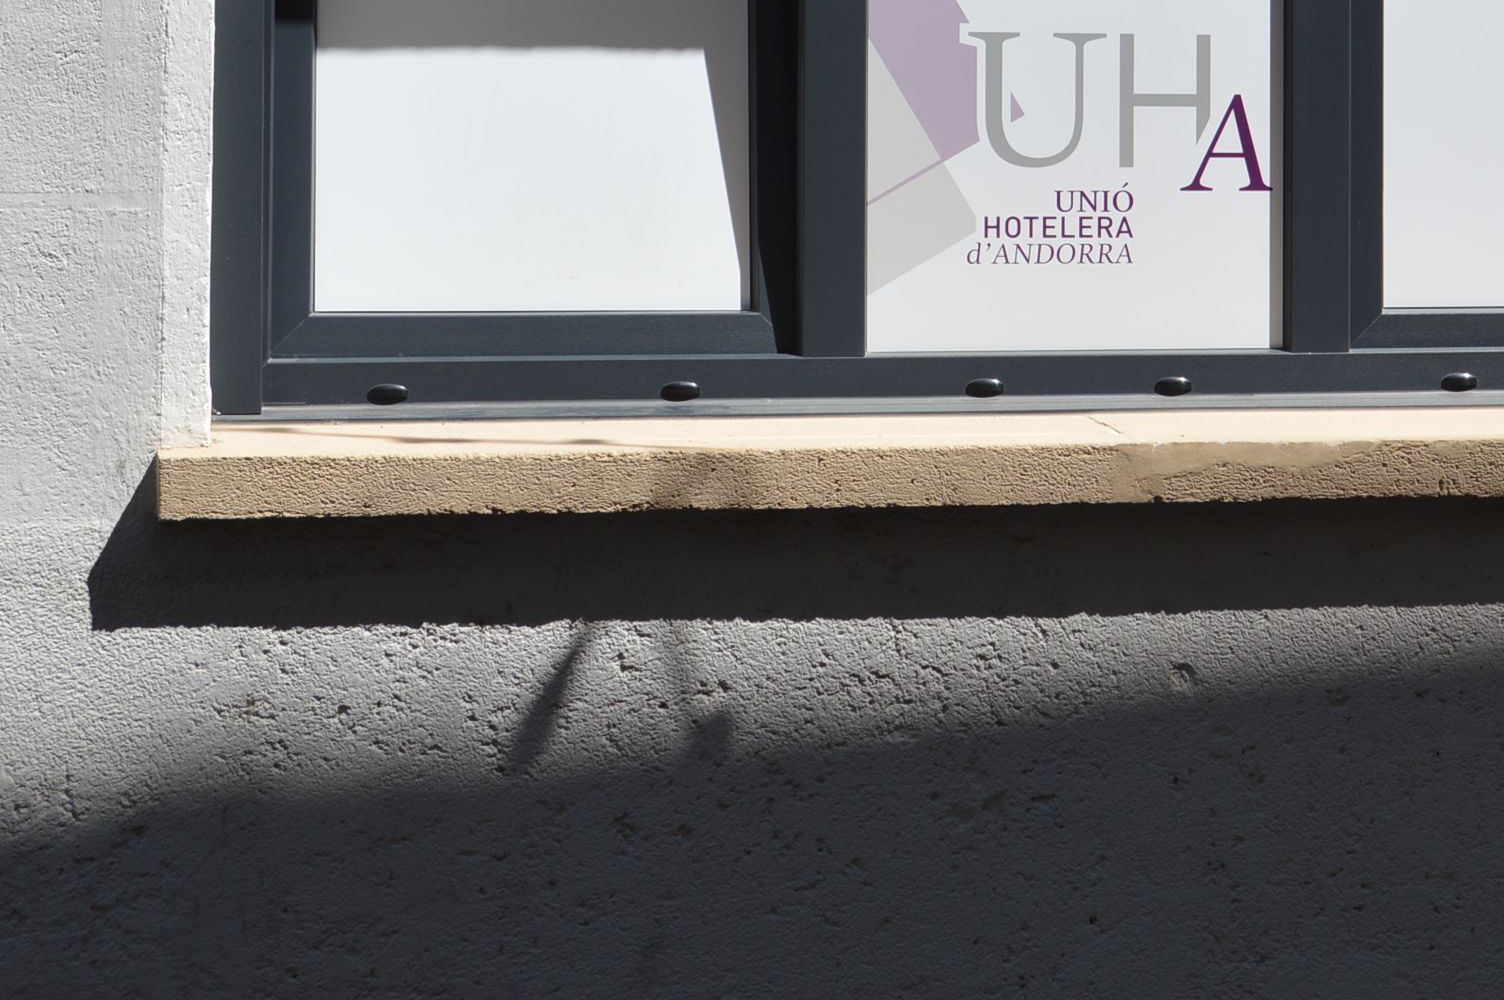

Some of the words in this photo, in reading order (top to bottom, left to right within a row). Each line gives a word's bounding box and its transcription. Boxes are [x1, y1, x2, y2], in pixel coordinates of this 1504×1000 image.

[967, 31, 1274, 193] UHA
[1053, 181, 1135, 214] UNIÓ
[983, 215, 1135, 240] HOTELERA
[965, 242, 1135, 266] d'ANDORRA
